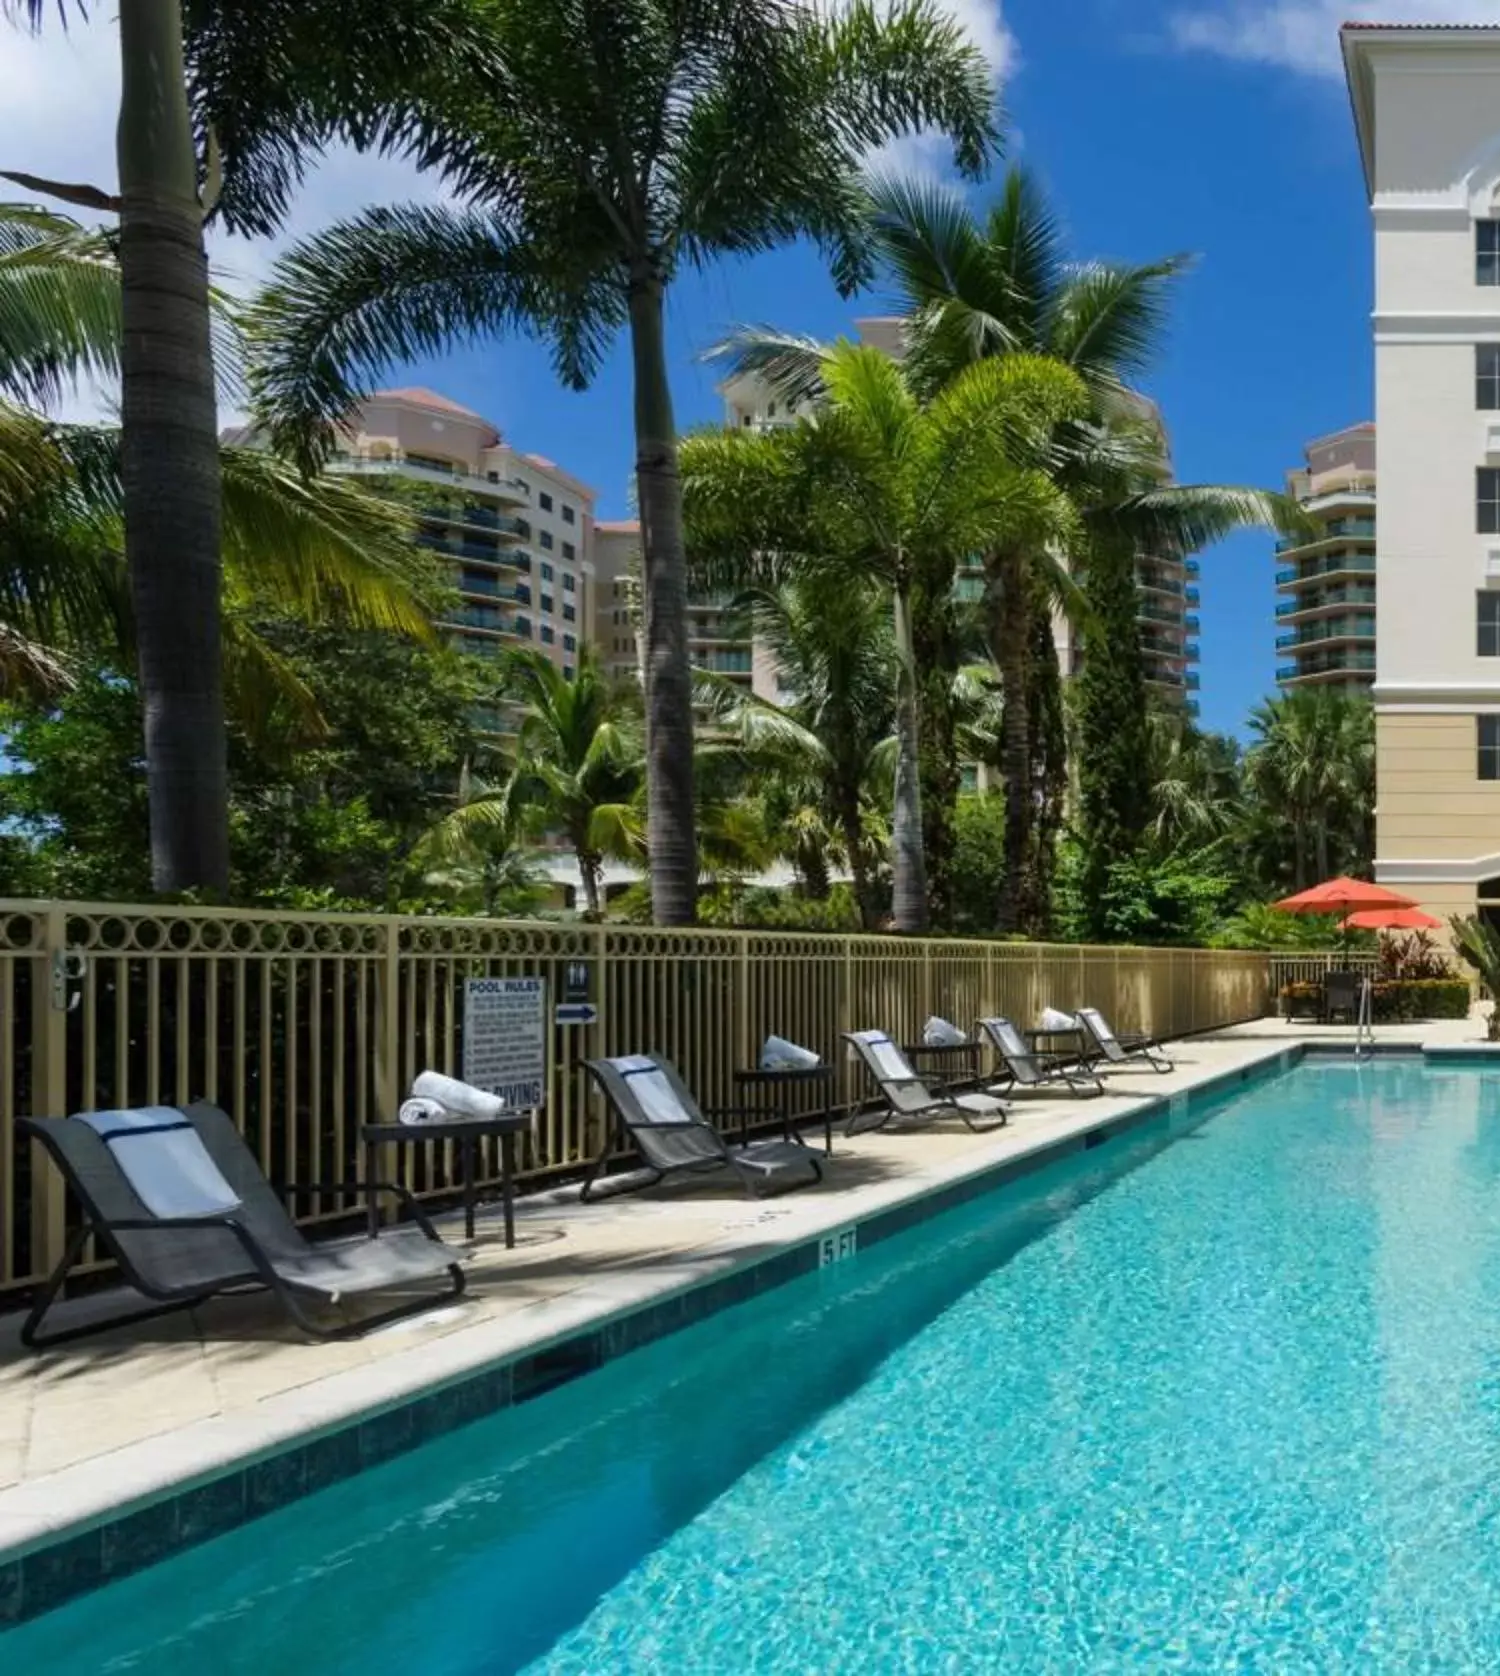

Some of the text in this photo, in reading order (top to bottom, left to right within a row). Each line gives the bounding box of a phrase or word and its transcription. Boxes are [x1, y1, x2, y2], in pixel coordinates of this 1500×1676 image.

[469, 980, 541, 993] POOL RULES
[823, 1229, 857, 1264] 5 FT
